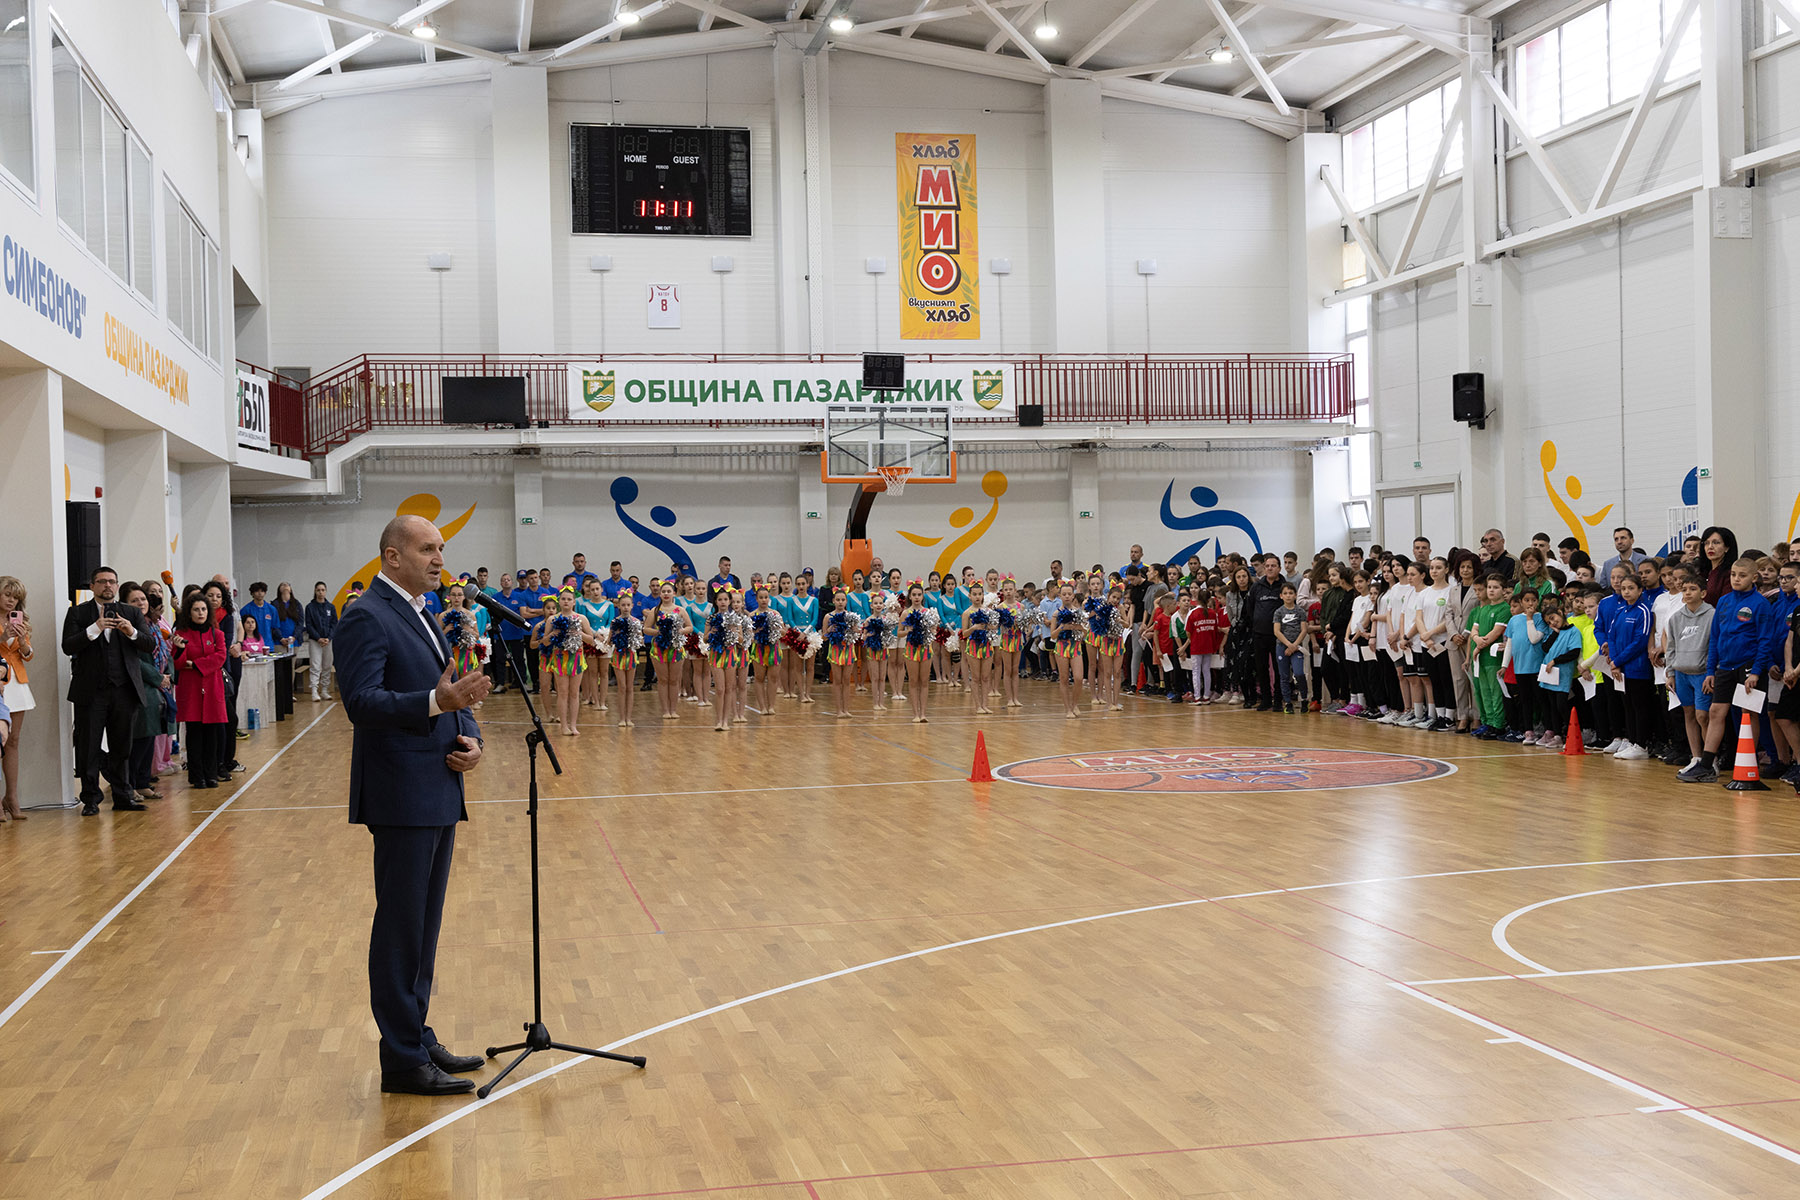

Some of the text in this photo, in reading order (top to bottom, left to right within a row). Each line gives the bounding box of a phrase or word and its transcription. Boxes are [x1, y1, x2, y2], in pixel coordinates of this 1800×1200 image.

[624, 155, 699, 164] HOME GUEST
[641, 200, 693, 217] 11:11
[915, 166, 960, 294] МИО
[661, 299, 668, 312] 8
[104, 311, 190, 407] ОБЩИНА ПАЗАРДЖИК
[624, 379, 764, 407] ОБЩИНА
[1071, 751, 1287, 769] МИО
